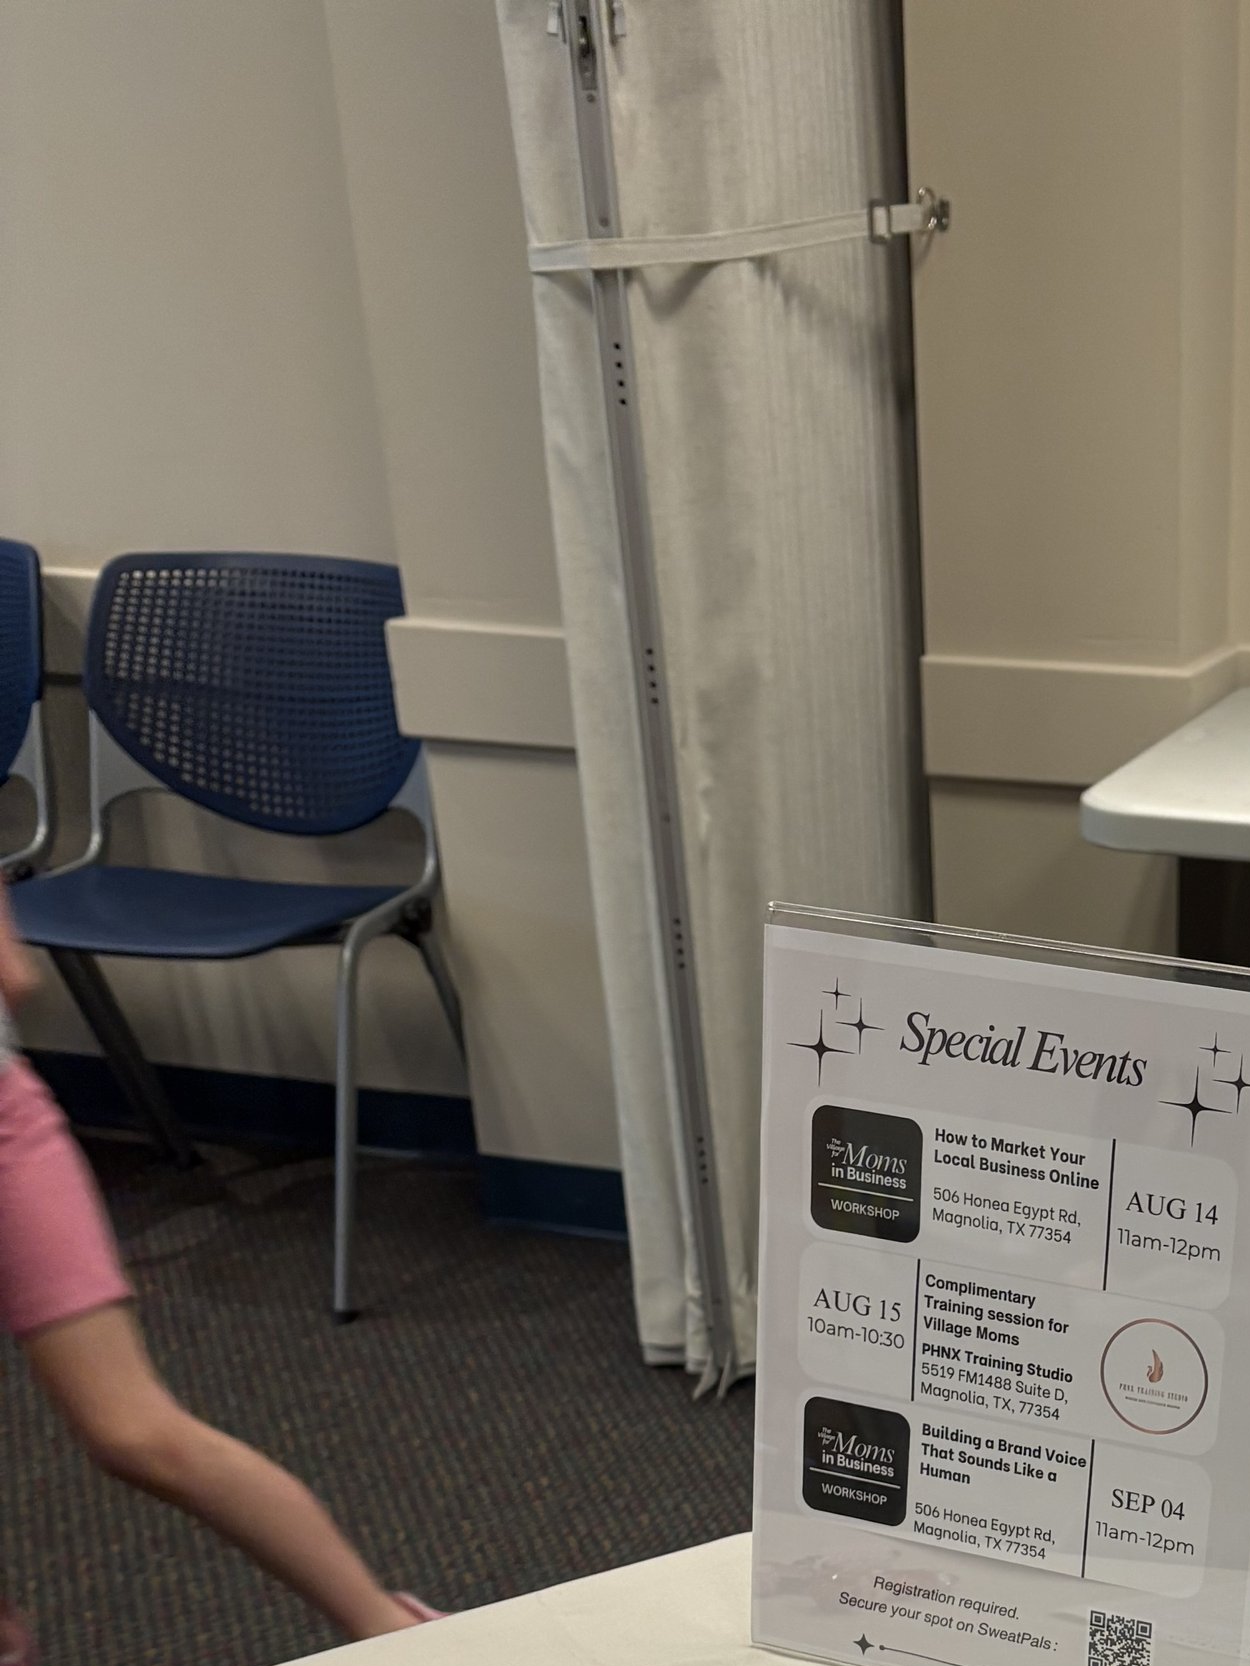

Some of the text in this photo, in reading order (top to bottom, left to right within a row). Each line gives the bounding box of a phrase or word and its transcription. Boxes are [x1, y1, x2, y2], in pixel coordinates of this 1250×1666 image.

[899, 1011, 1147, 1087] Special Events
[841, 1142, 908, 1174] Moms
[934, 1127, 1086, 1166] How to Market Your
[831, 1162, 906, 1189] in Business
[934, 1148, 1100, 1190] Local Business Online
[830, 1198, 900, 1220] WORKSHOP
[932, 1207, 1072, 1244] Magnolia, TX 77354
[933, 1186, 1081, 1228] 506 Honea Egypt Rd,
[1125, 1191, 1218, 1225] AUG 14
[1116, 1227, 1221, 1262] 11am-12pm
[813, 1288, 901, 1322] AUG 15
[925, 1273, 1036, 1309] Complimentary
[807, 1316, 905, 1349] 10am-10:30
[923, 1294, 1069, 1334] Training session for
[923, 1315, 1020, 1346] Village Moms
[921, 1342, 1073, 1383] PHNX Training Studio
[920, 1381, 1060, 1421] Magnolia, TX, 77354
[921, 1361, 1068, 1405] 5519 FM1488 Suite D,
[920, 1442, 1057, 1482] That Sounds Like a
[921, 1422, 1087, 1468] Building a Brand Voice
[919, 1461, 971, 1484] Human
[1111, 1488, 1185, 1521] SEP 04
[873, 1575, 1019, 1620] Registration required.
[838, 1591, 1058, 1652] Secure your spot on SweatPals:
